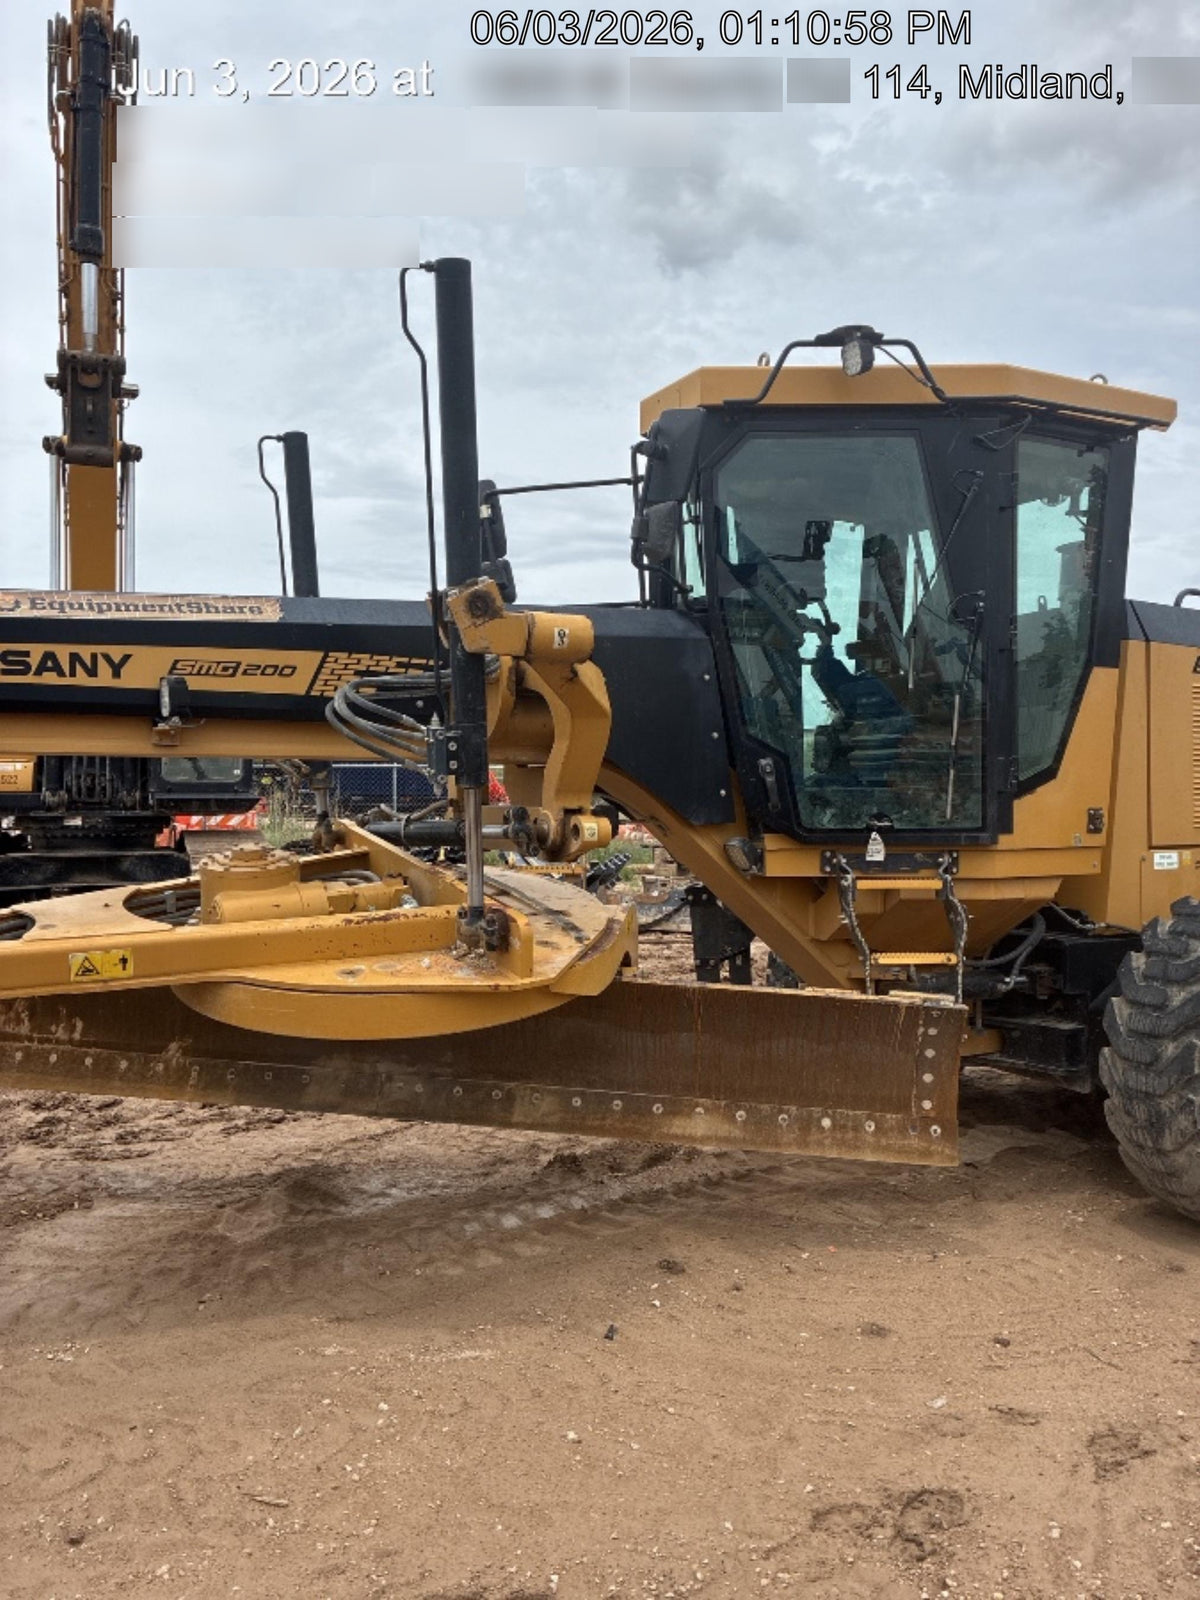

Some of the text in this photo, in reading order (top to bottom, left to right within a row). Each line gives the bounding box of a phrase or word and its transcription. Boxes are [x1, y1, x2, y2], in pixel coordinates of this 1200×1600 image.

[28, 597, 264, 615] EquipmentShare
[0, 650, 133, 679] SANY
[241, 664, 297, 677] 200
